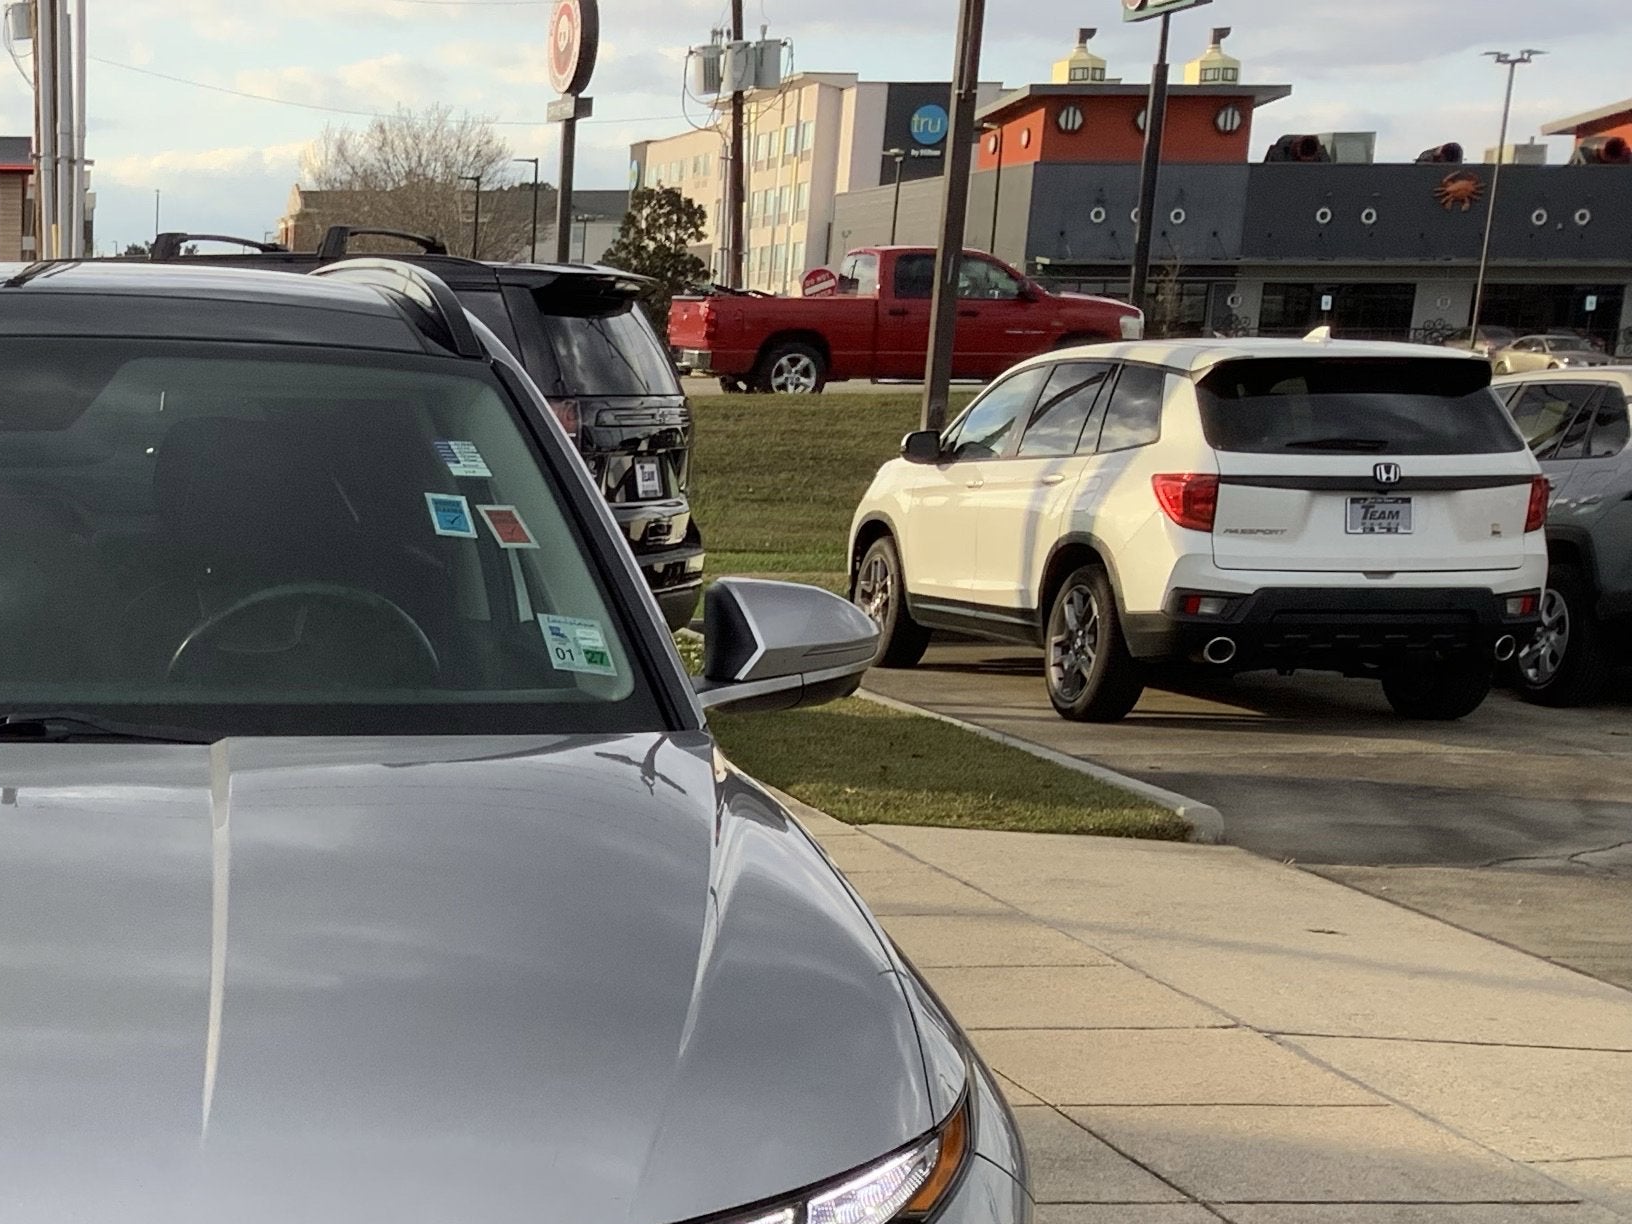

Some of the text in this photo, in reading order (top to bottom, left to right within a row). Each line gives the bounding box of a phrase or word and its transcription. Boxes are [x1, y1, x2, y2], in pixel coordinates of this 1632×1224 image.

[911, 113, 941, 133] tru
[1361, 504, 1400, 520] TEAM
[555, 647, 575, 662] 01
